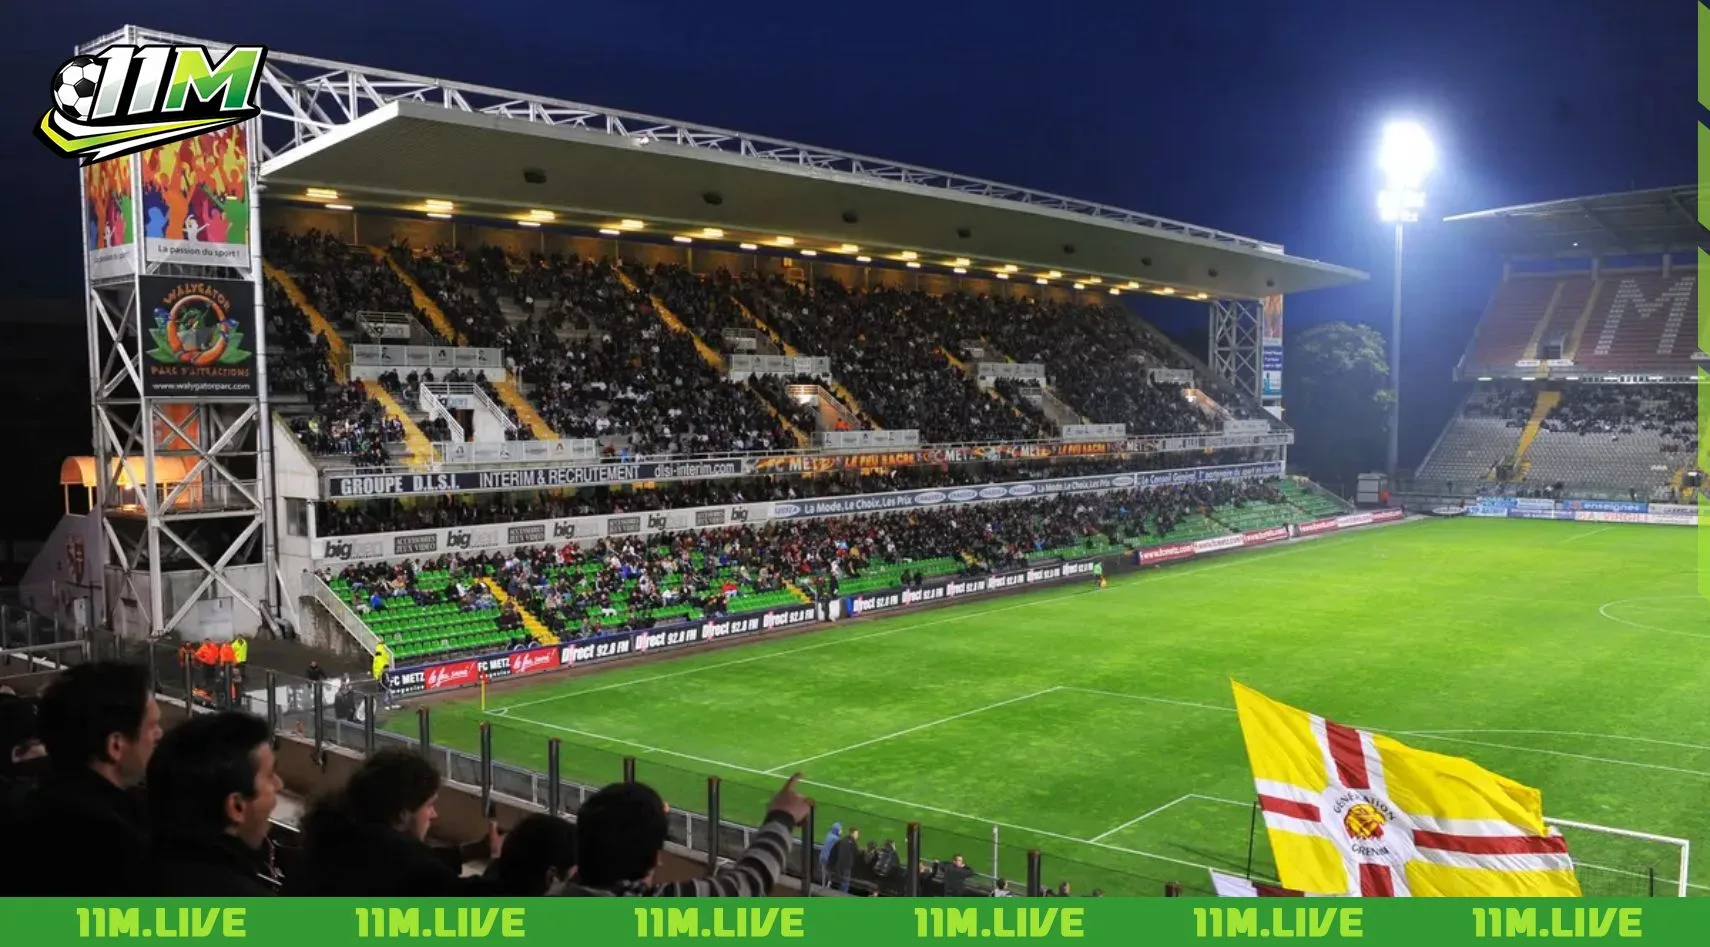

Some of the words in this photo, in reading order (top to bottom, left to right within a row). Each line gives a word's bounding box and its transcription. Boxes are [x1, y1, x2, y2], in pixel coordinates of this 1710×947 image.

[158, 245, 168, 253] La
[170, 246, 200, 255] passion
[202, 248, 213, 256] du
[163, 281, 231, 313] WALYGATOR
[150, 366, 178, 375] PARC
[152, 381, 251, 391] www.walygatorparc.com
[341, 476, 403, 495] GROUPE
[413, 473, 460, 491] D.L.S.I.
[480, 470, 535, 488] INTERIM
[537, 469, 545, 484] &
[549, 465, 639, 485] RECRUTEMENT
[654, 462, 735, 478] dlsi-interim.com
[804, 503, 816, 514] La
[845, 500, 855, 511] Le
[897, 495, 912, 505] Prix
[702, 621, 729, 640] Direct
[731, 620, 747, 633] 92.8
[748, 618, 759, 630] FM
[763, 611, 788, 630] Direct
[805, 608, 814, 620] FM
[635, 632, 665, 652] Direct
[668, 630, 684, 644] 92.8
[686, 628, 697, 641] FM
[561, 644, 594, 665] Direct
[596, 641, 616, 656] 92.8
[617, 640, 629, 653] FM
[478, 660, 488, 672] FC
[490, 657, 511, 670] METZ
[390, 675, 400, 687] FC
[402, 671, 425, 685] METZ
